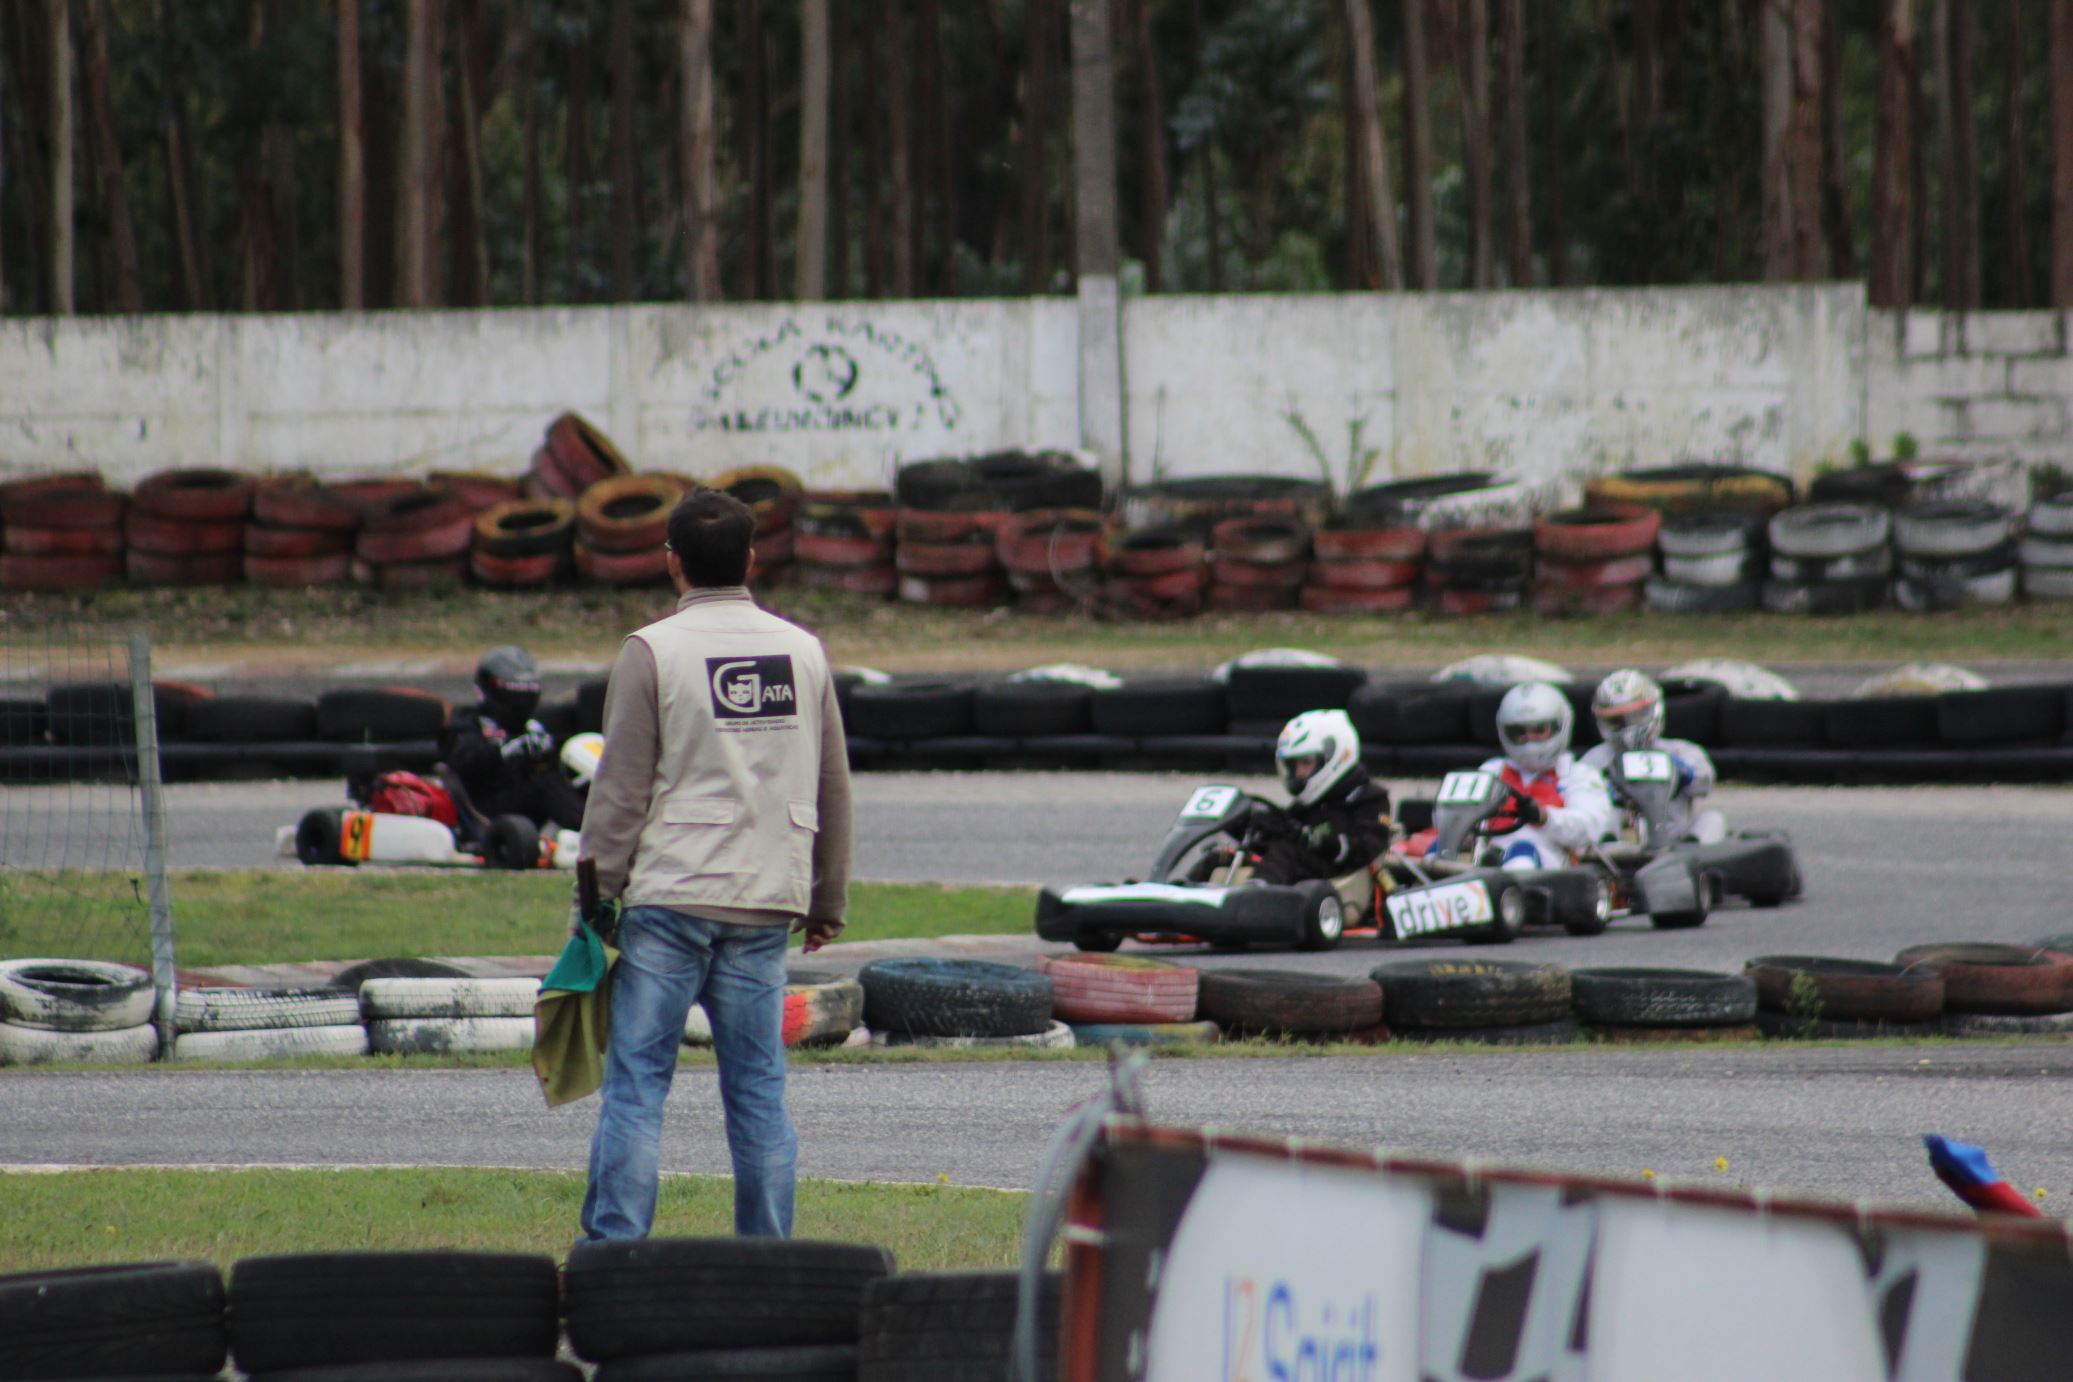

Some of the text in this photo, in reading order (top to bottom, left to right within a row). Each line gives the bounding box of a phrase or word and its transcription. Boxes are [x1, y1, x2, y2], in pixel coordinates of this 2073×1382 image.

[713, 660, 794, 713] GATA
[1196, 790, 1223, 812] 6
[1449, 776, 1479, 798] 11
[1398, 890, 1472, 933] drive
